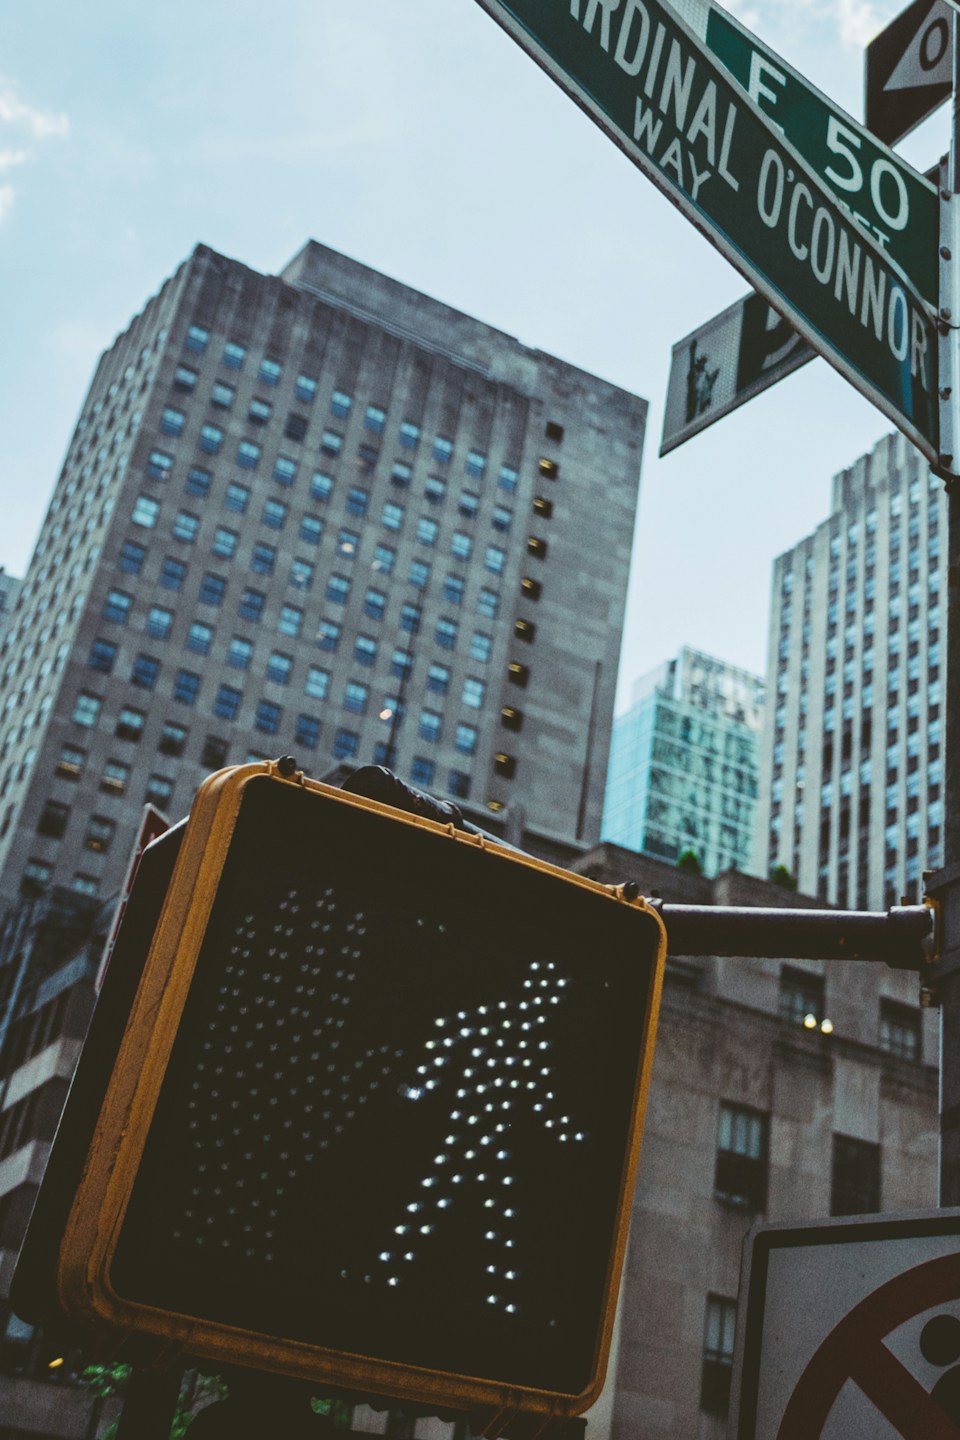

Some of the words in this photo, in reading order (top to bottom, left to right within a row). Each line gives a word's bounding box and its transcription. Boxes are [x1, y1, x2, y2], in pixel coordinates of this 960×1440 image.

[633, 95, 712, 203] WAY
[824, 115, 909, 231] 50
[757, 148, 928, 392] O'CONNOR
